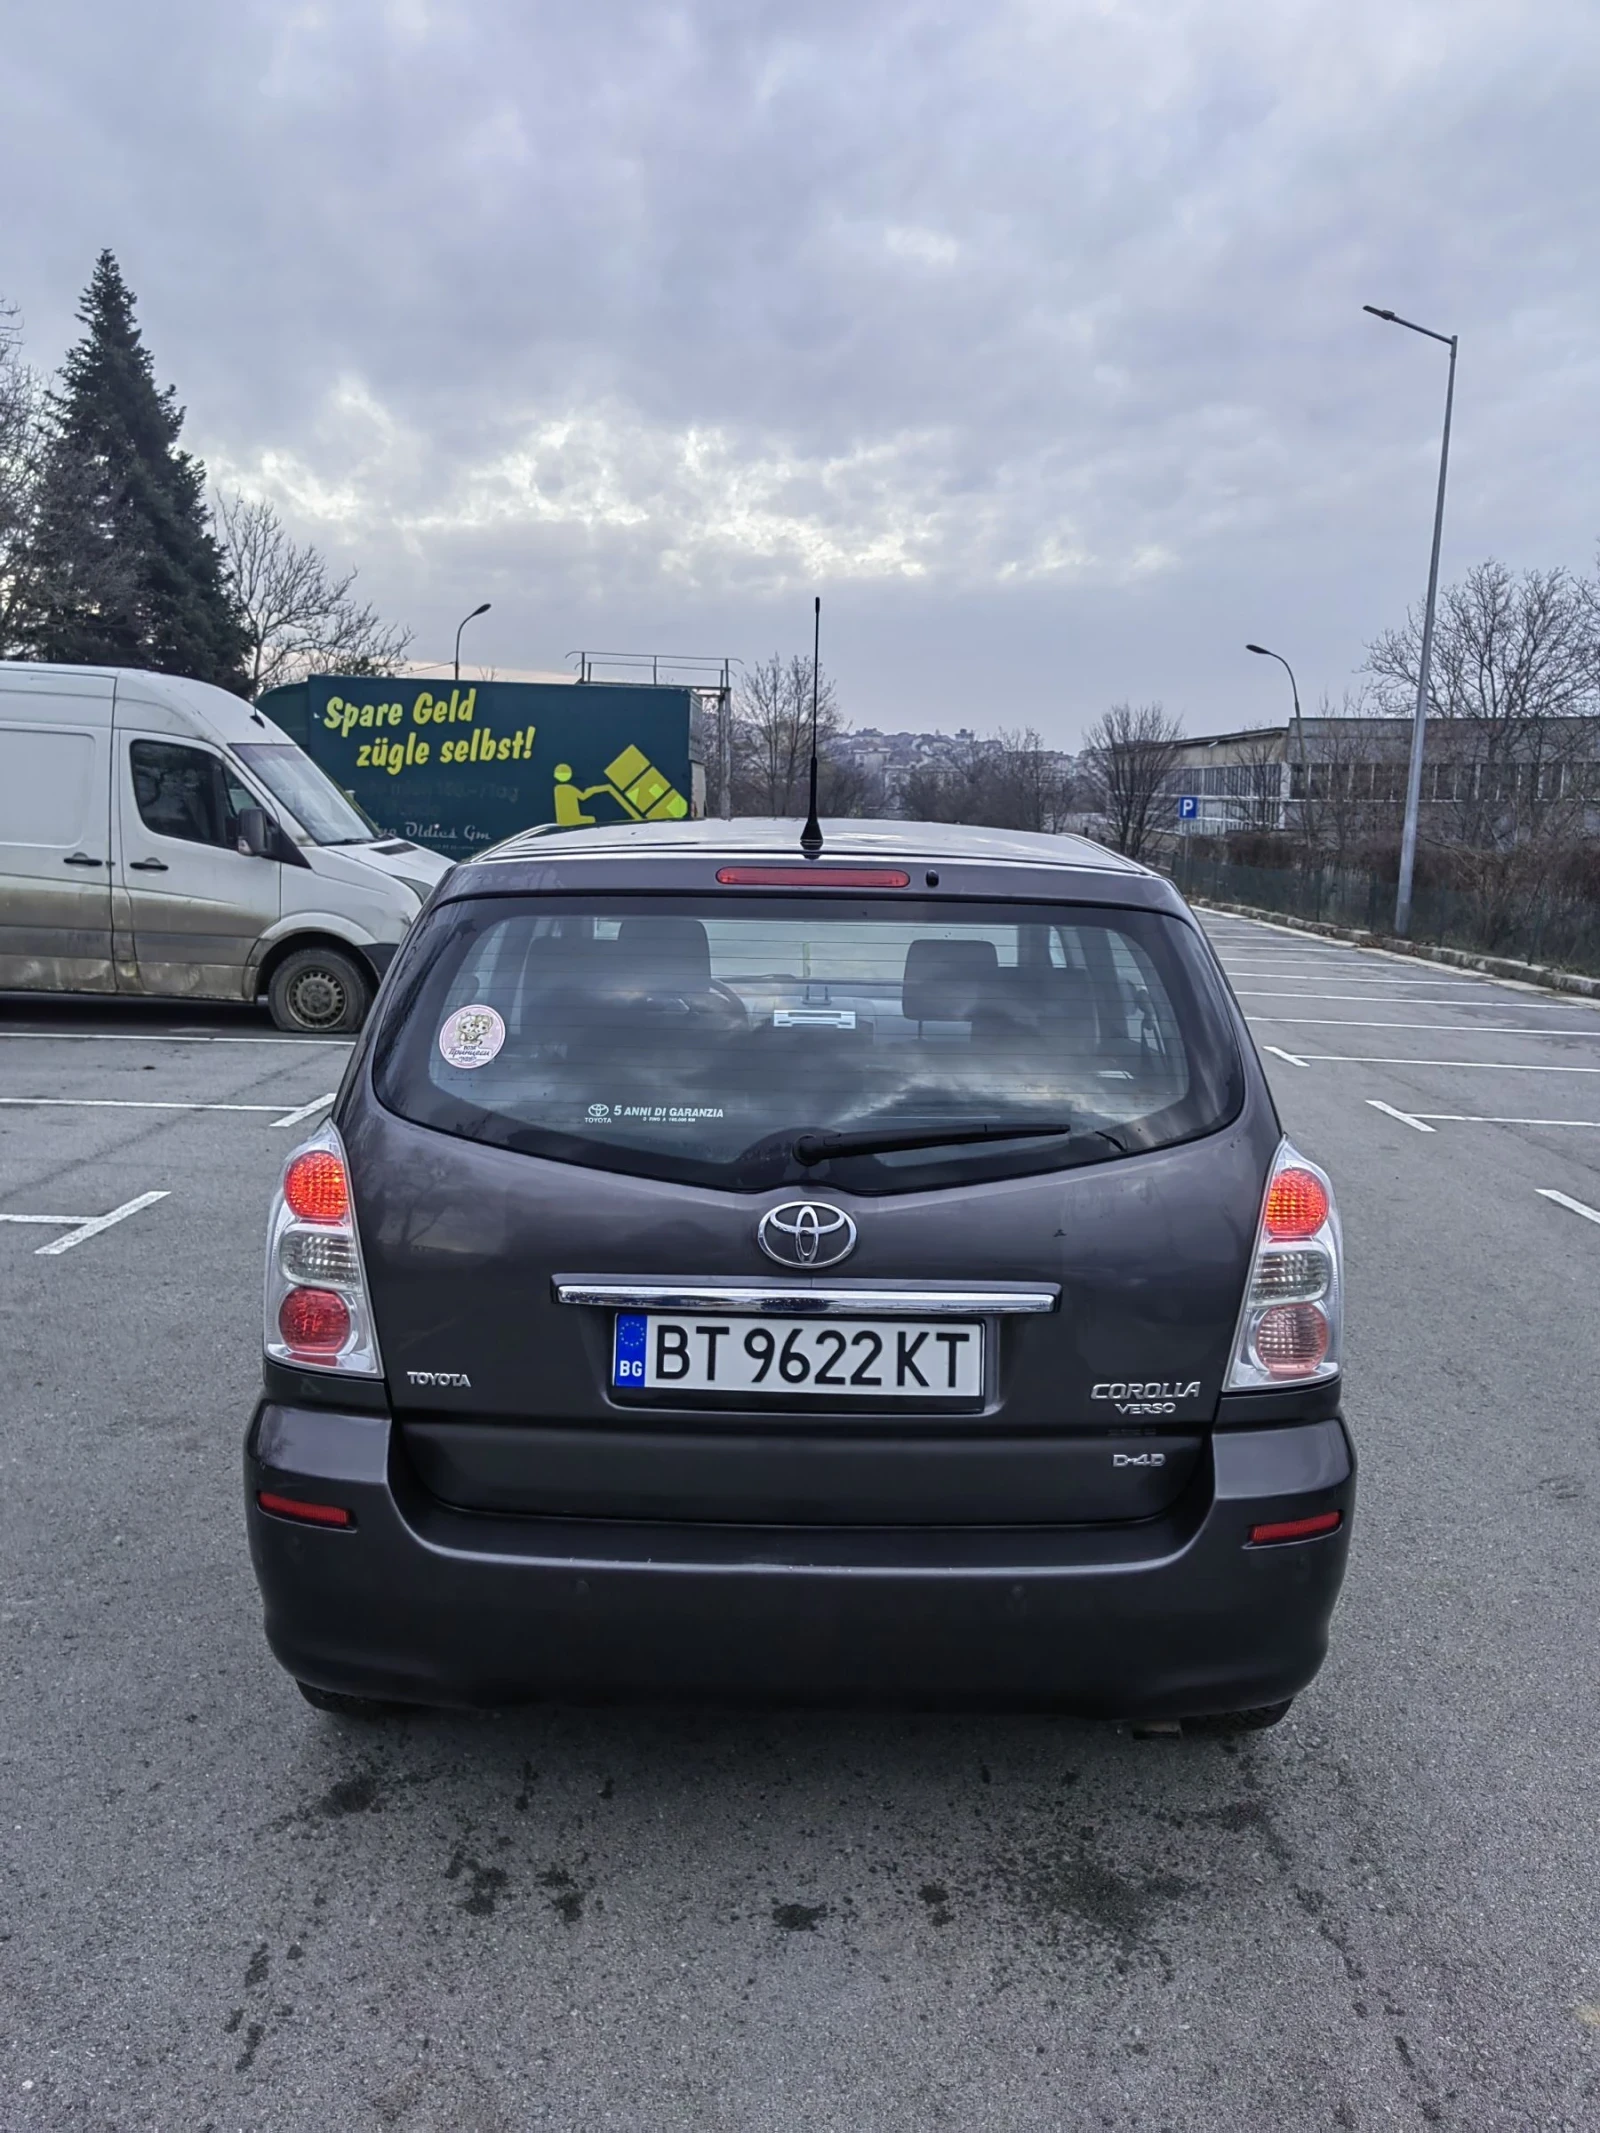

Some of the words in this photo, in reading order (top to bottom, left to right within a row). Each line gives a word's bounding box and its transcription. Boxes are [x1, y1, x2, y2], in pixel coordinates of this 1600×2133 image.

[323, 696, 404, 738] Spare
[413, 687, 477, 725] Geld
[356, 731, 430, 775] zügle
[439, 726, 536, 764] selbst!
[1182, 799, 1194, 817] P
[404, 821, 458, 838] Oldies
[613, 1105, 622, 1116] 5
[624, 1106, 652, 1117] ANNI
[654, 1107, 666, 1117] DI
[669, 1107, 724, 1118] GARANZIA
[656, 1324, 730, 1381] BT
[744, 1327, 883, 1386] 9622
[897, 1331, 970, 1388] KT
[619, 1360, 643, 1377] BG
[406, 1371, 472, 1388] TOYOTA
[1090, 1381, 1201, 1400] COROLLA
[1114, 1402, 1176, 1414] VERSO
[1112, 1453, 1166, 1467] D-4D
